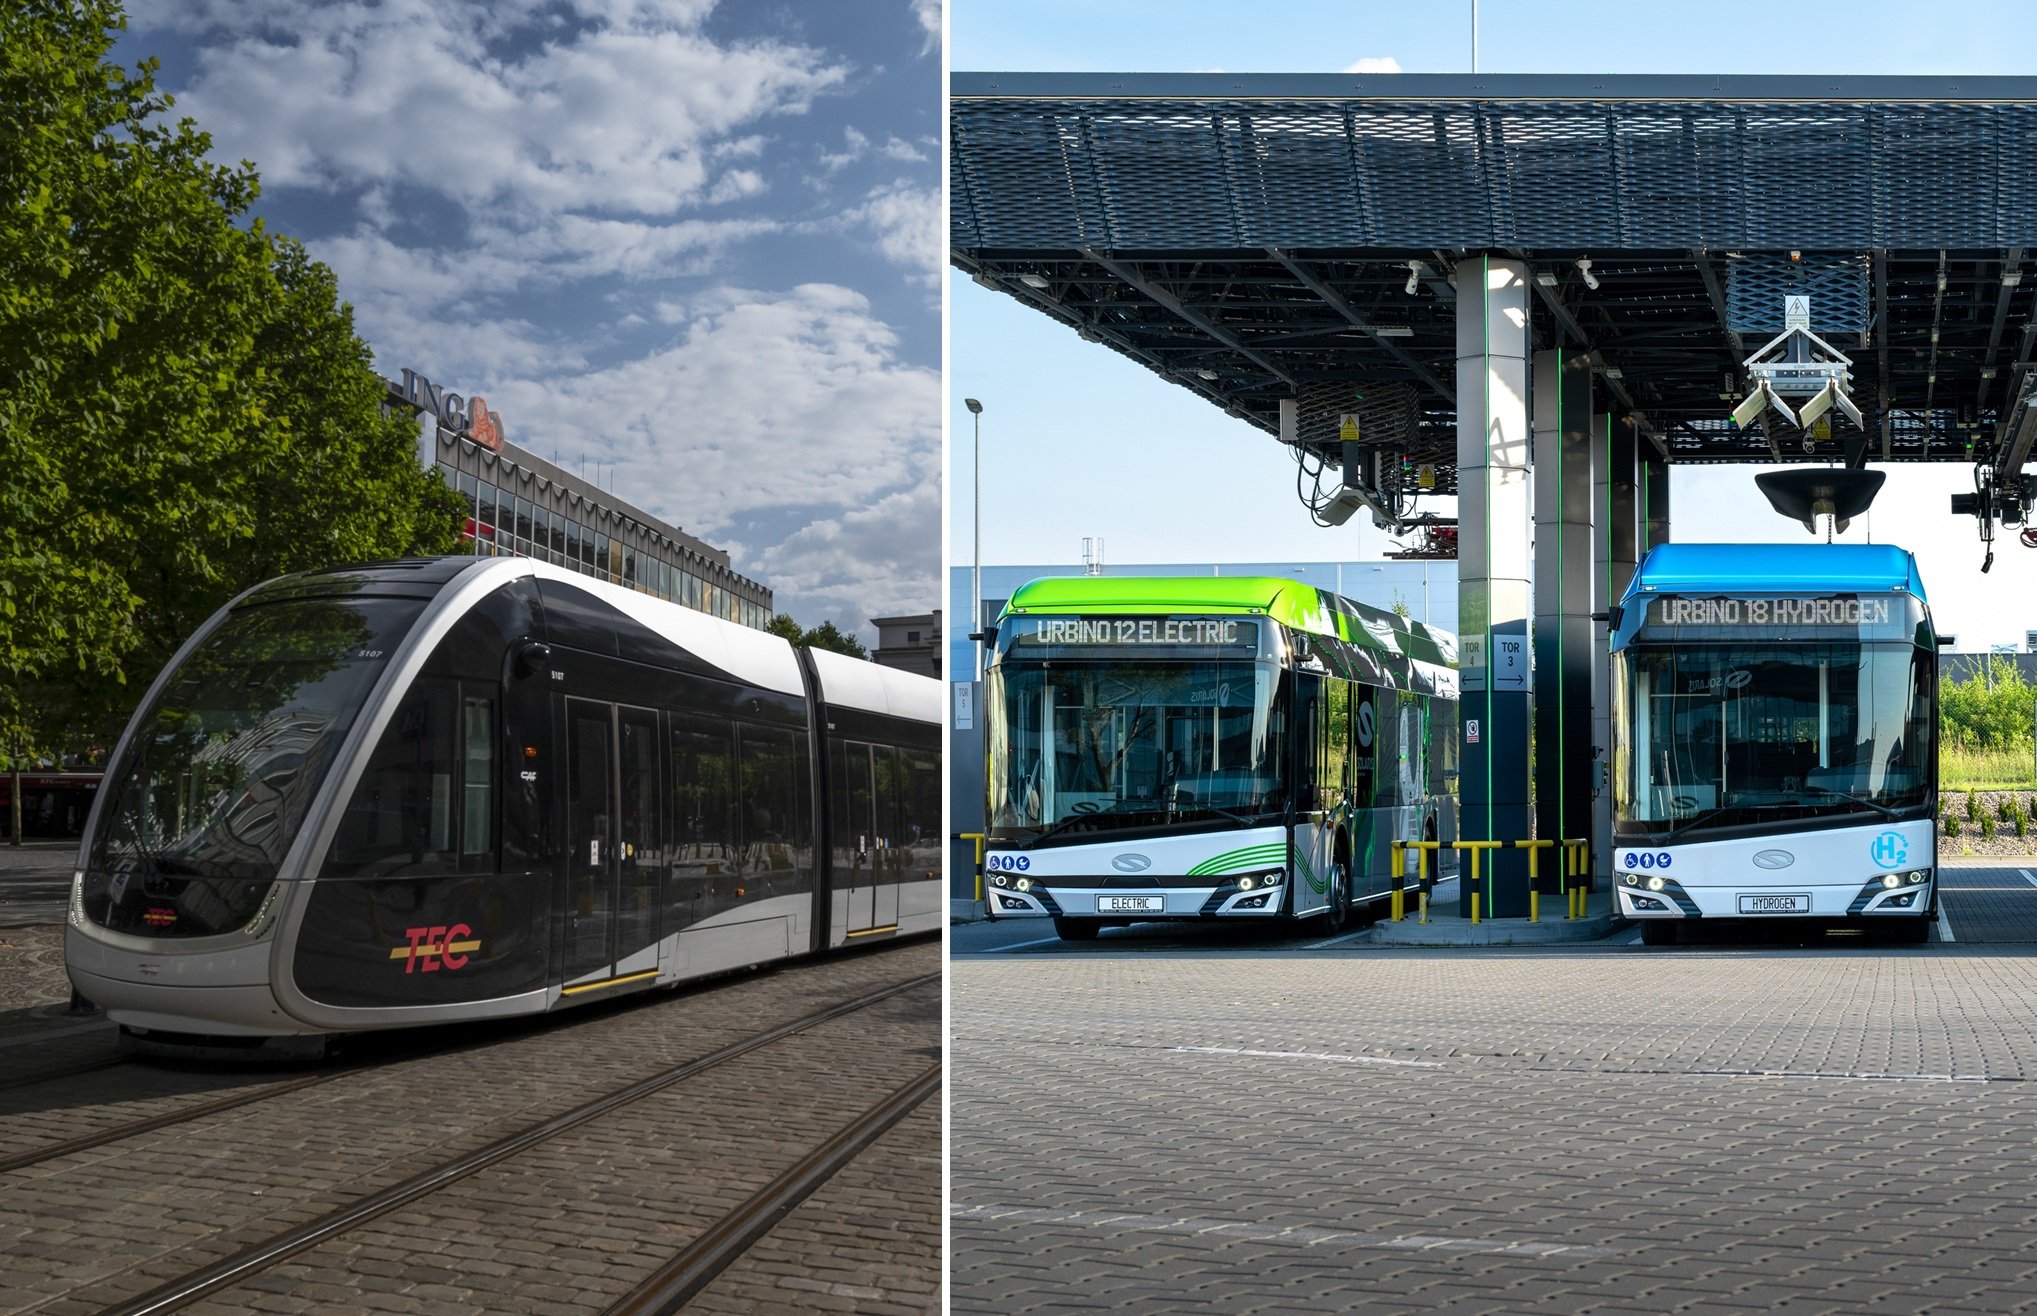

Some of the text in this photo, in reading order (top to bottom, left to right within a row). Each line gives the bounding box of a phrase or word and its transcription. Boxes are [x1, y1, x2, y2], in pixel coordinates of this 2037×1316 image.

[401, 367, 466, 432] ING
[1662, 599, 1888, 624] URBINO 18 HYDROGEN
[1037, 620, 1238, 643] URBINO 12 ELECTRIC
[1464, 642, 1480, 653] TOR
[1501, 641, 1520, 653] TOR
[358, 649, 383, 658] 5107
[1469, 656, 1475, 667] 4
[1507, 656, 1514, 667] 3
[958, 687, 969, 697] TOR
[1111, 898, 1150, 909] ELECTRIC
[1752, 897, 1796, 909] HYDROGEN
[405, 923, 472, 974] TEC
